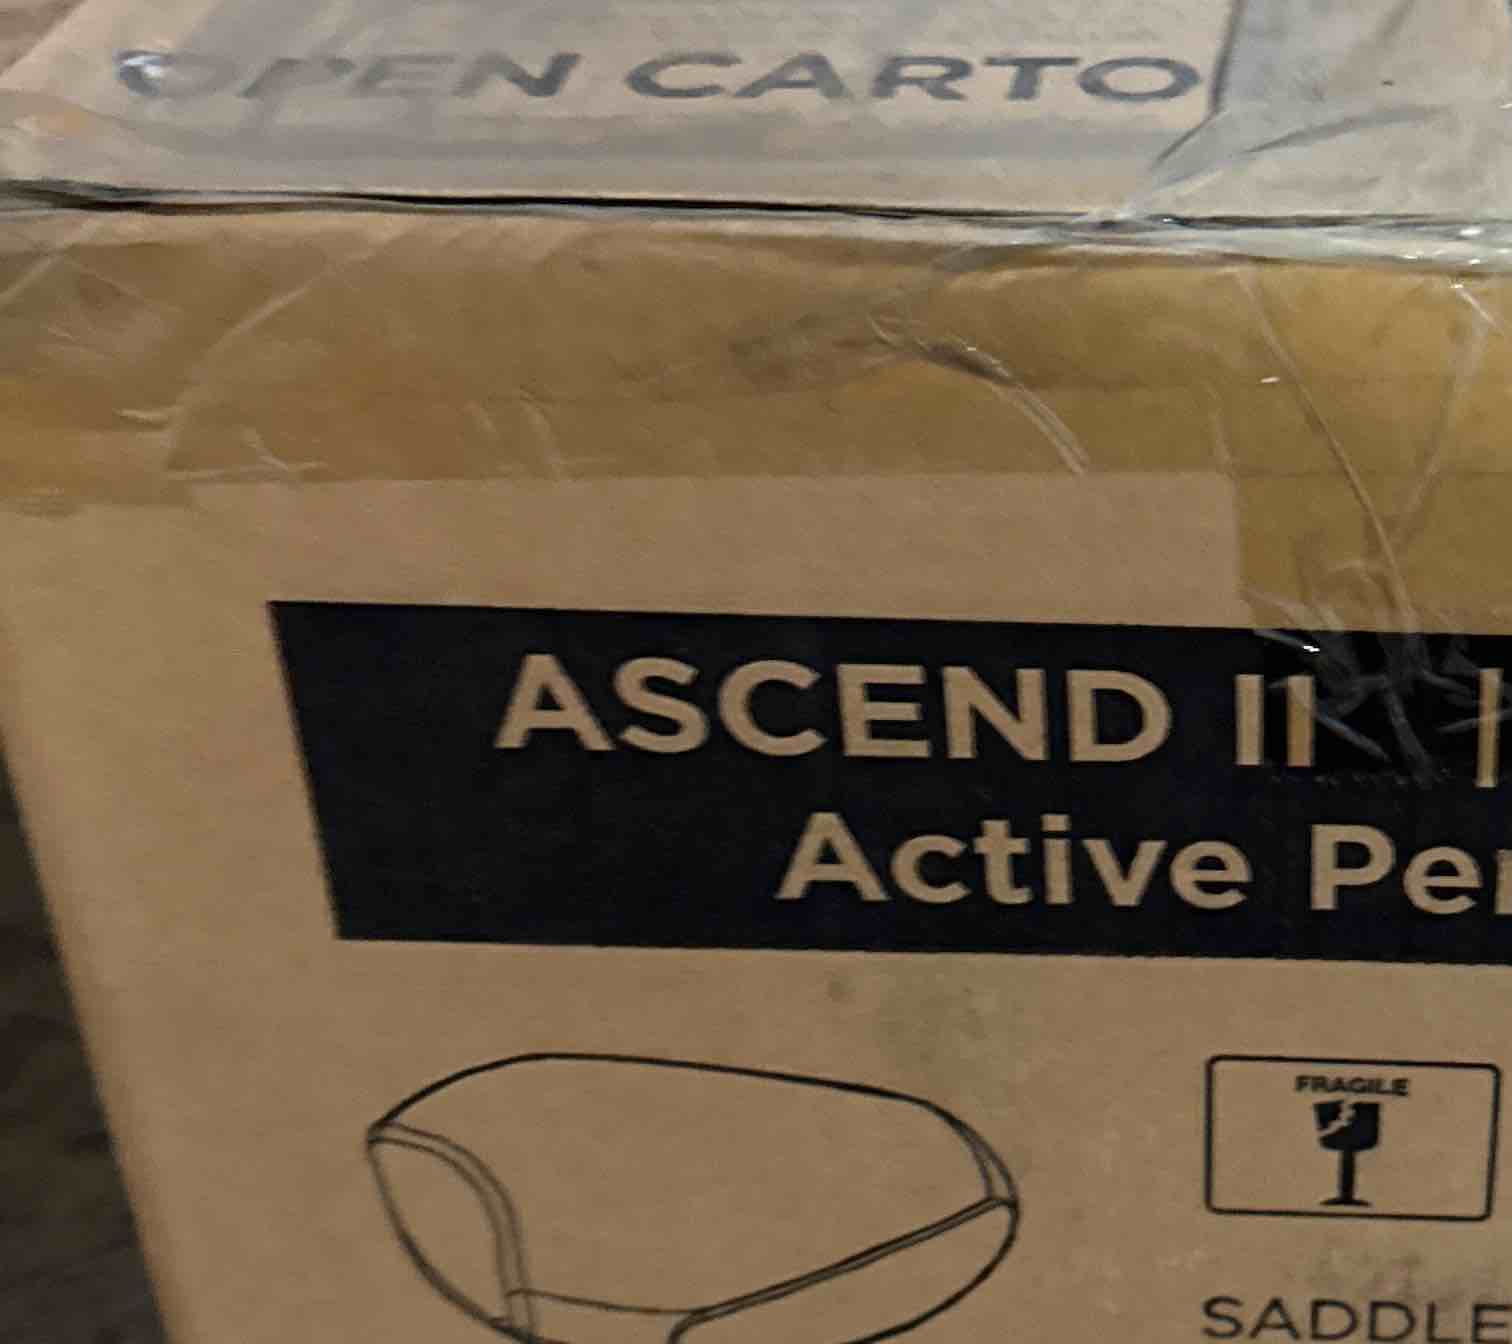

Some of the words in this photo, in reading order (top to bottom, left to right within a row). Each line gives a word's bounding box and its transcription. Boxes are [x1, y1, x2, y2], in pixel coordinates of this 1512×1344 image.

[492, 652, 1173, 763] ASCEND
[775, 810, 1253, 909] Active
[1294, 1074, 1410, 1098] FRAGILE
